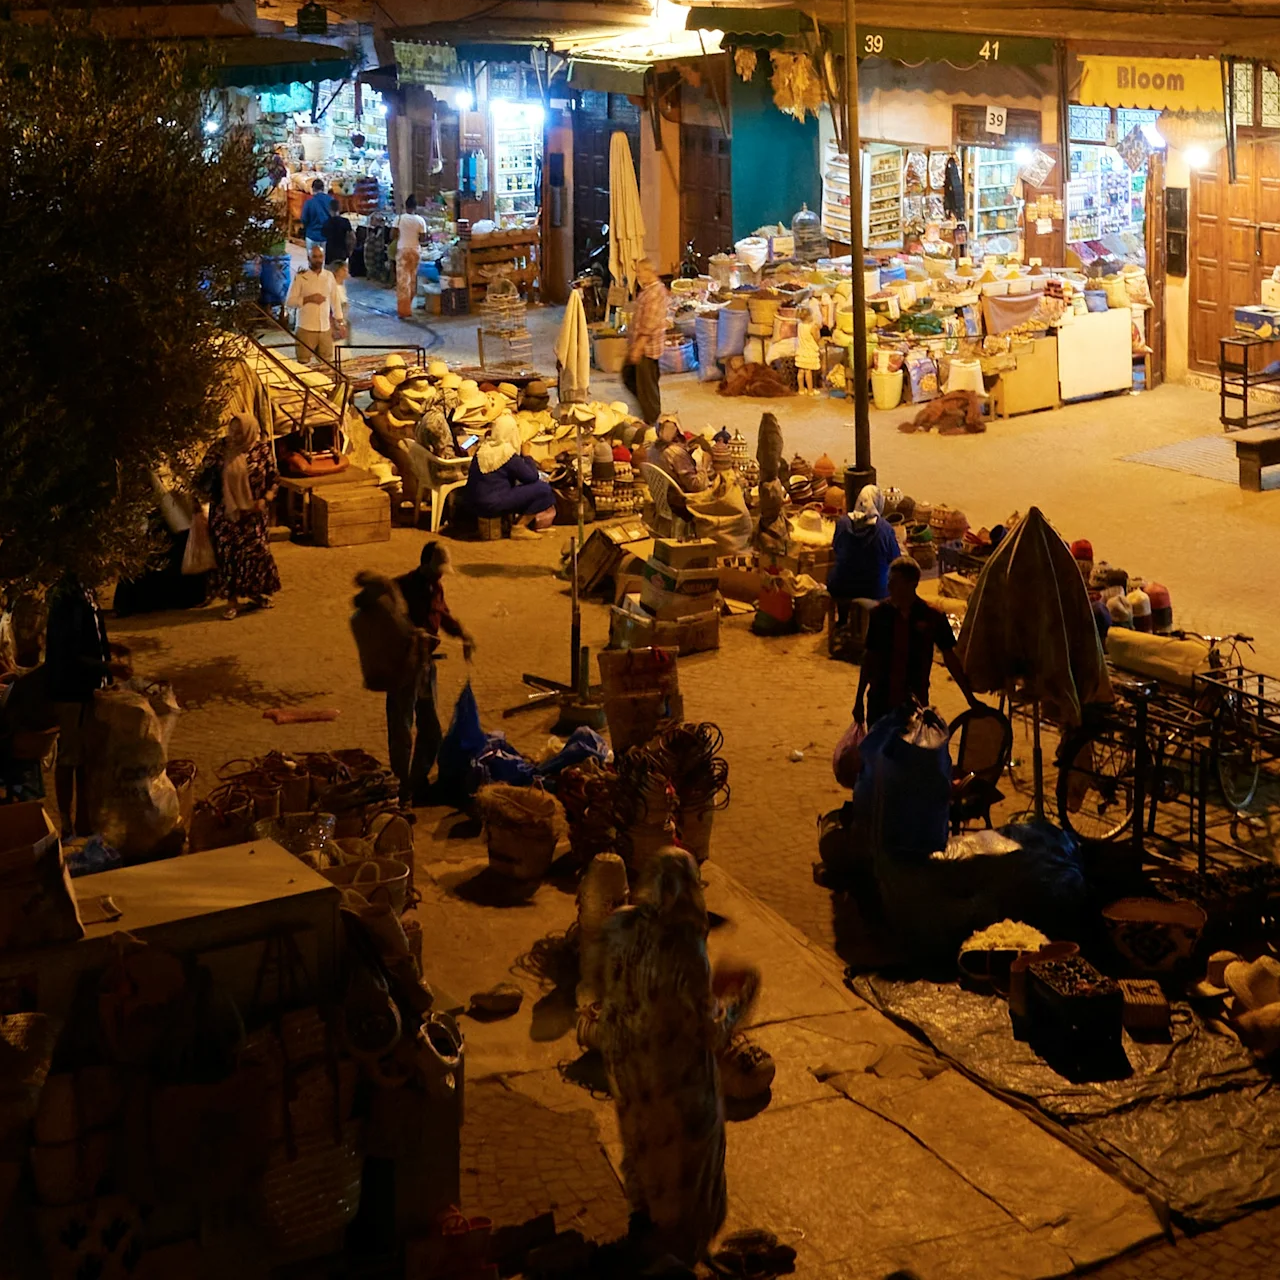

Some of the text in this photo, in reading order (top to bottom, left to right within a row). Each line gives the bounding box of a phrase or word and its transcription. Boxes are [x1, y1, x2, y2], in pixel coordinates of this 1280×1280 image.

[864, 35, 884, 53] 39
[979, 40, 1000, 61] 41
[1117, 66, 1185, 91] Bloom
[988, 113, 1004, 127] 39
